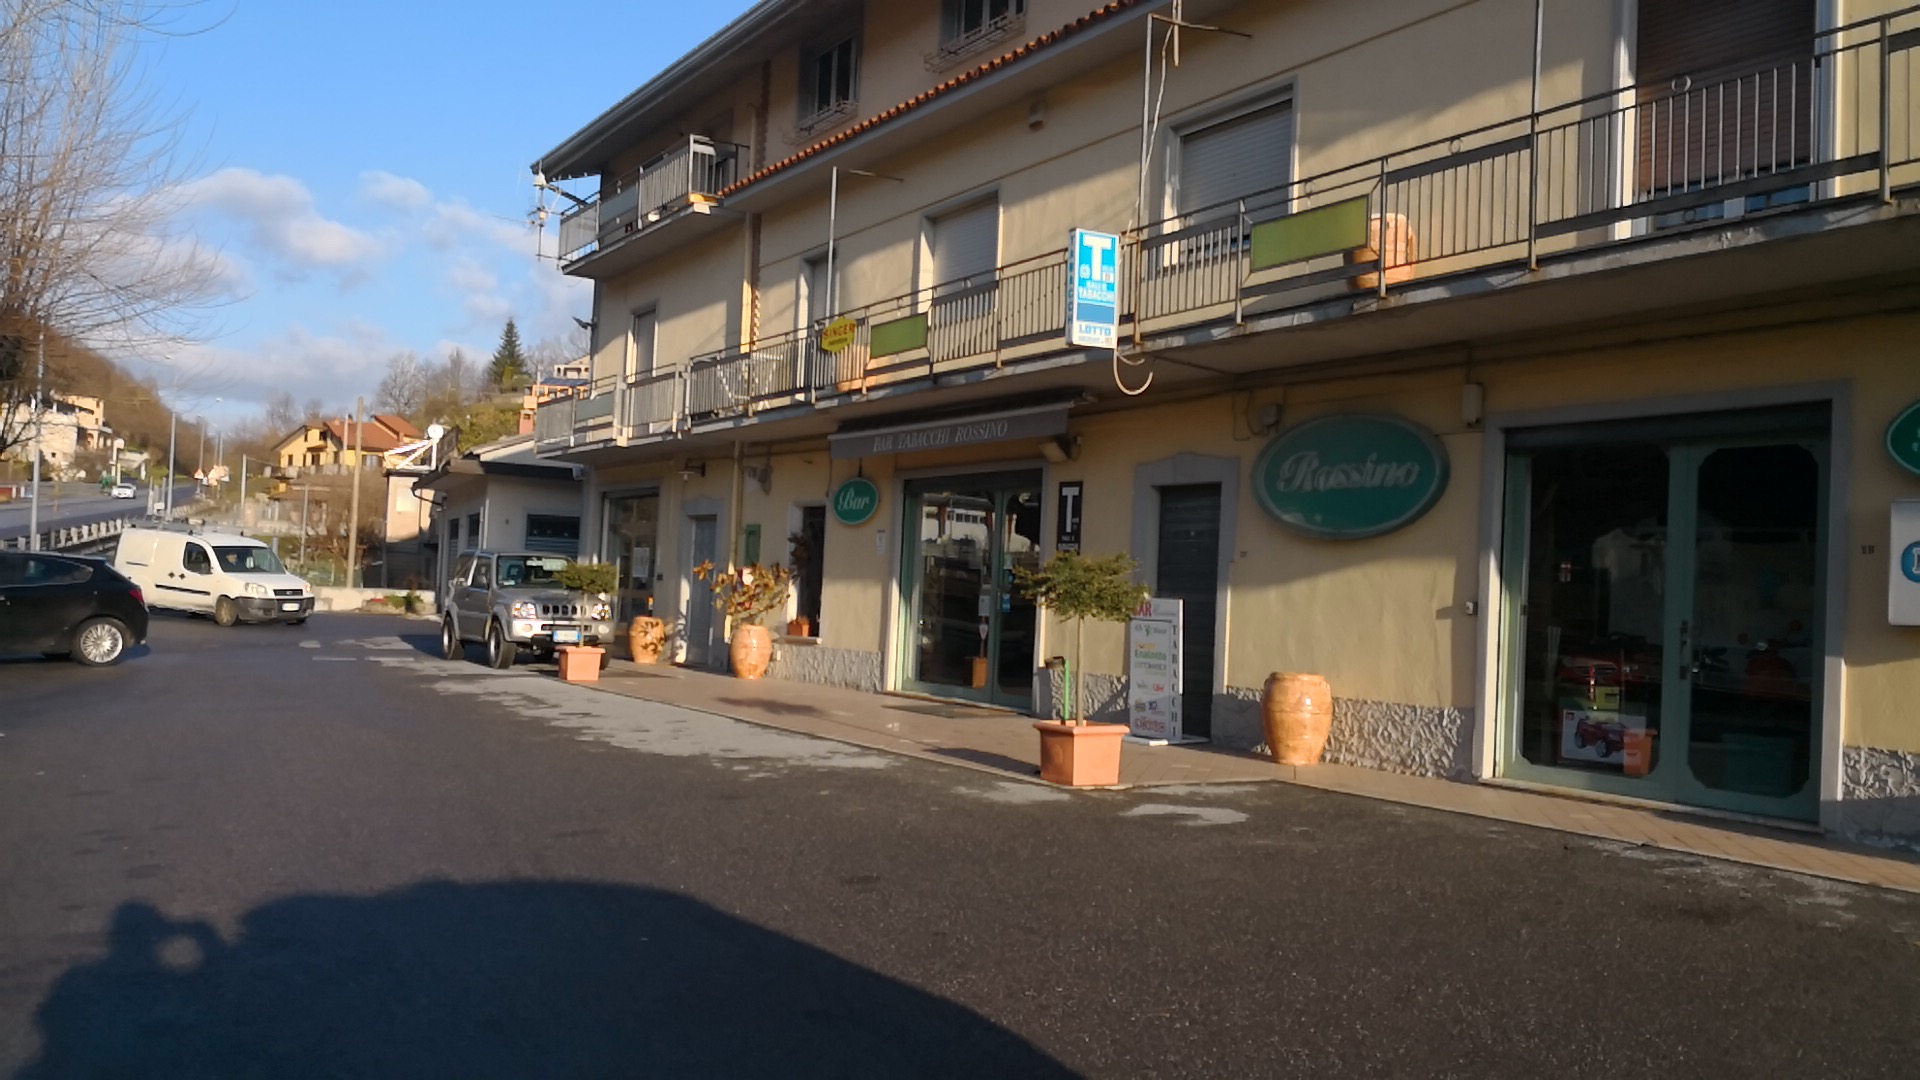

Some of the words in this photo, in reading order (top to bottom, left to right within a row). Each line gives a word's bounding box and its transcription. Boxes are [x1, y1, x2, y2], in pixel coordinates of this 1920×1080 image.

[1082, 233, 1112, 282] T
[1079, 323, 1112, 338] LOTTO
[873, 436, 893, 452] BAR
[898, 427, 950, 449] TABACCHI
[955, 420, 1008, 443] ROSSINO
[1276, 451, 1421, 493] Rossino
[837, 488, 870, 512] Bar
[1061, 486, 1080, 533] T
